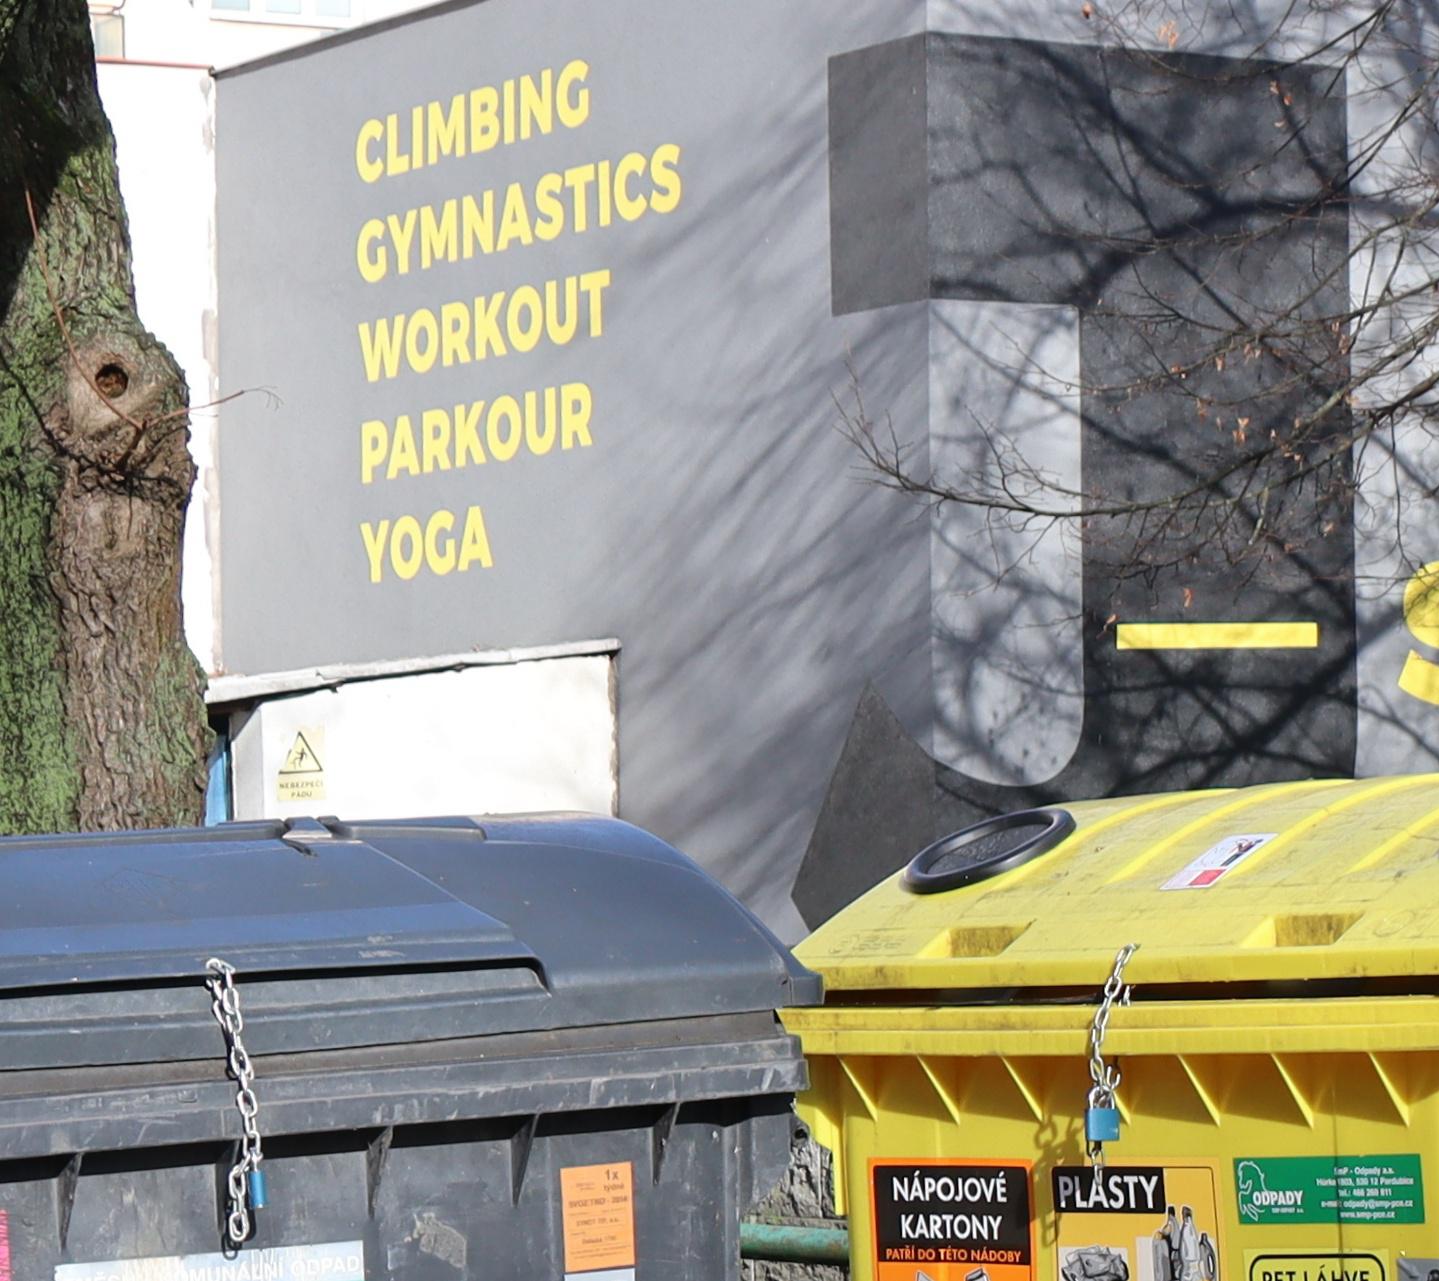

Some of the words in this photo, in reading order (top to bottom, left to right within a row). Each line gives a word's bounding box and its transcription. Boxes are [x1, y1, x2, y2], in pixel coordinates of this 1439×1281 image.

[356, 60, 589, 182] CLIMBING
[357, 144, 681, 282] GYMNASTICS
[358, 270, 611, 381] WORKOUT
[361, 383, 593, 483] PARKOUR
[360, 506, 493, 582] YOGA
[891, 1170, 1008, 1203] NÁPOJOVÉ
[1058, 1174, 1159, 1210] PLASTY
[1252, 1190, 1304, 1206] ODPADY
[900, 1213, 1003, 1241] KARTONY
[290, 1255, 361, 1277] ODPAD
[885, 1245, 915, 1261] PATŘÍ
[917, 1248, 936, 1261] DO
[938, 1245, 968, 1261] TÉTO
[970, 1246, 1022, 1264] NÁDOBY
